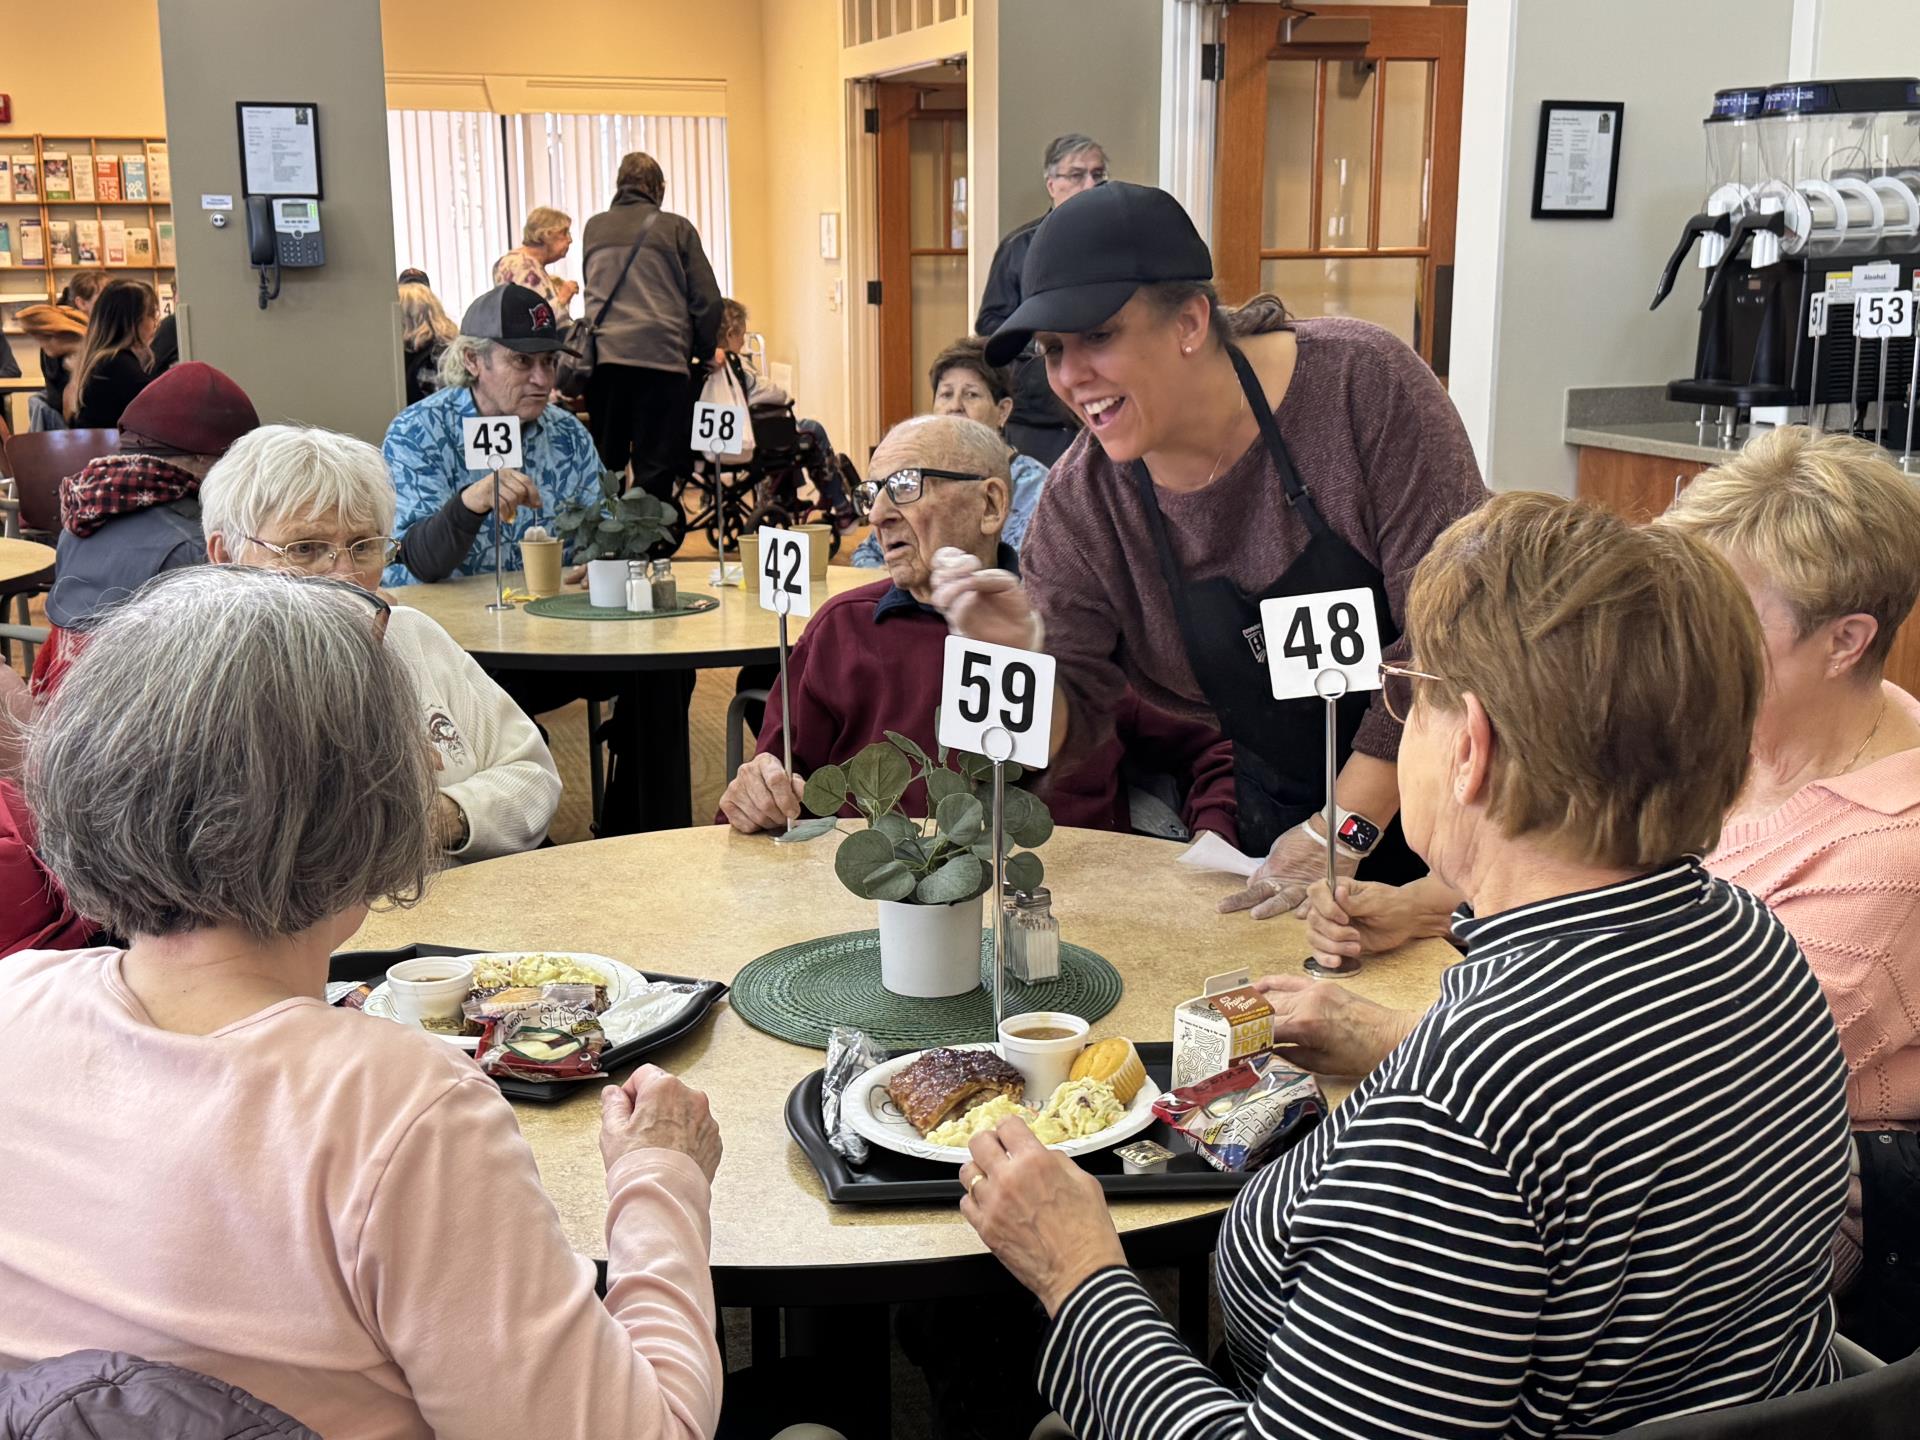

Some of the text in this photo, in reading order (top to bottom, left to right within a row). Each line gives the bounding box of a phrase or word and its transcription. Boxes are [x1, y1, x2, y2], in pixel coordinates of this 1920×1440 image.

[1868, 297, 1904, 325] 53
[473, 422, 512, 456] 43
[699, 408, 735, 440] 58
[764, 537, 802, 595] 42
[1283, 602, 1364, 670] 48
[958, 650, 1037, 734] 59
